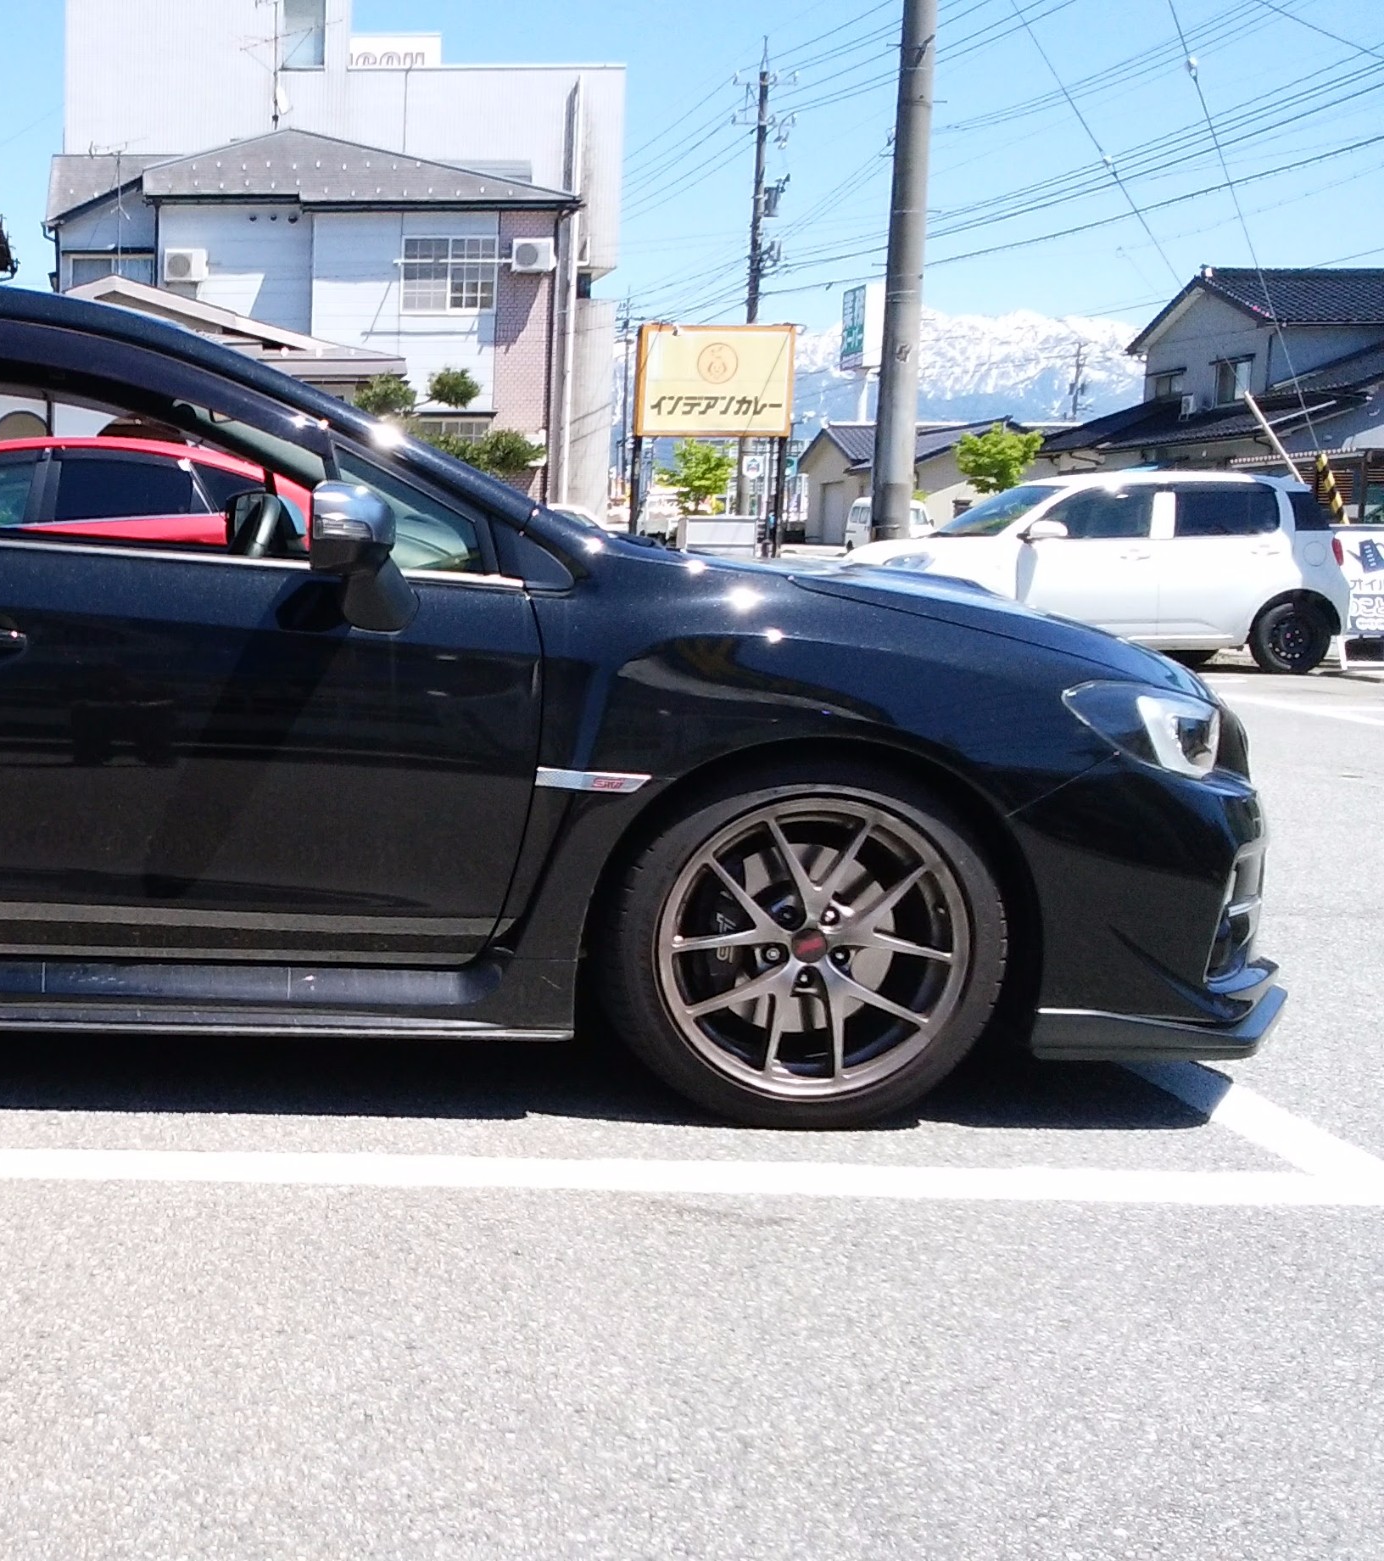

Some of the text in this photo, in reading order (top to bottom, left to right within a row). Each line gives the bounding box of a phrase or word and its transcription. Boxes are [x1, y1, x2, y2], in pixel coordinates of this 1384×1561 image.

[650, 396, 782, 415] インデアンカレー
